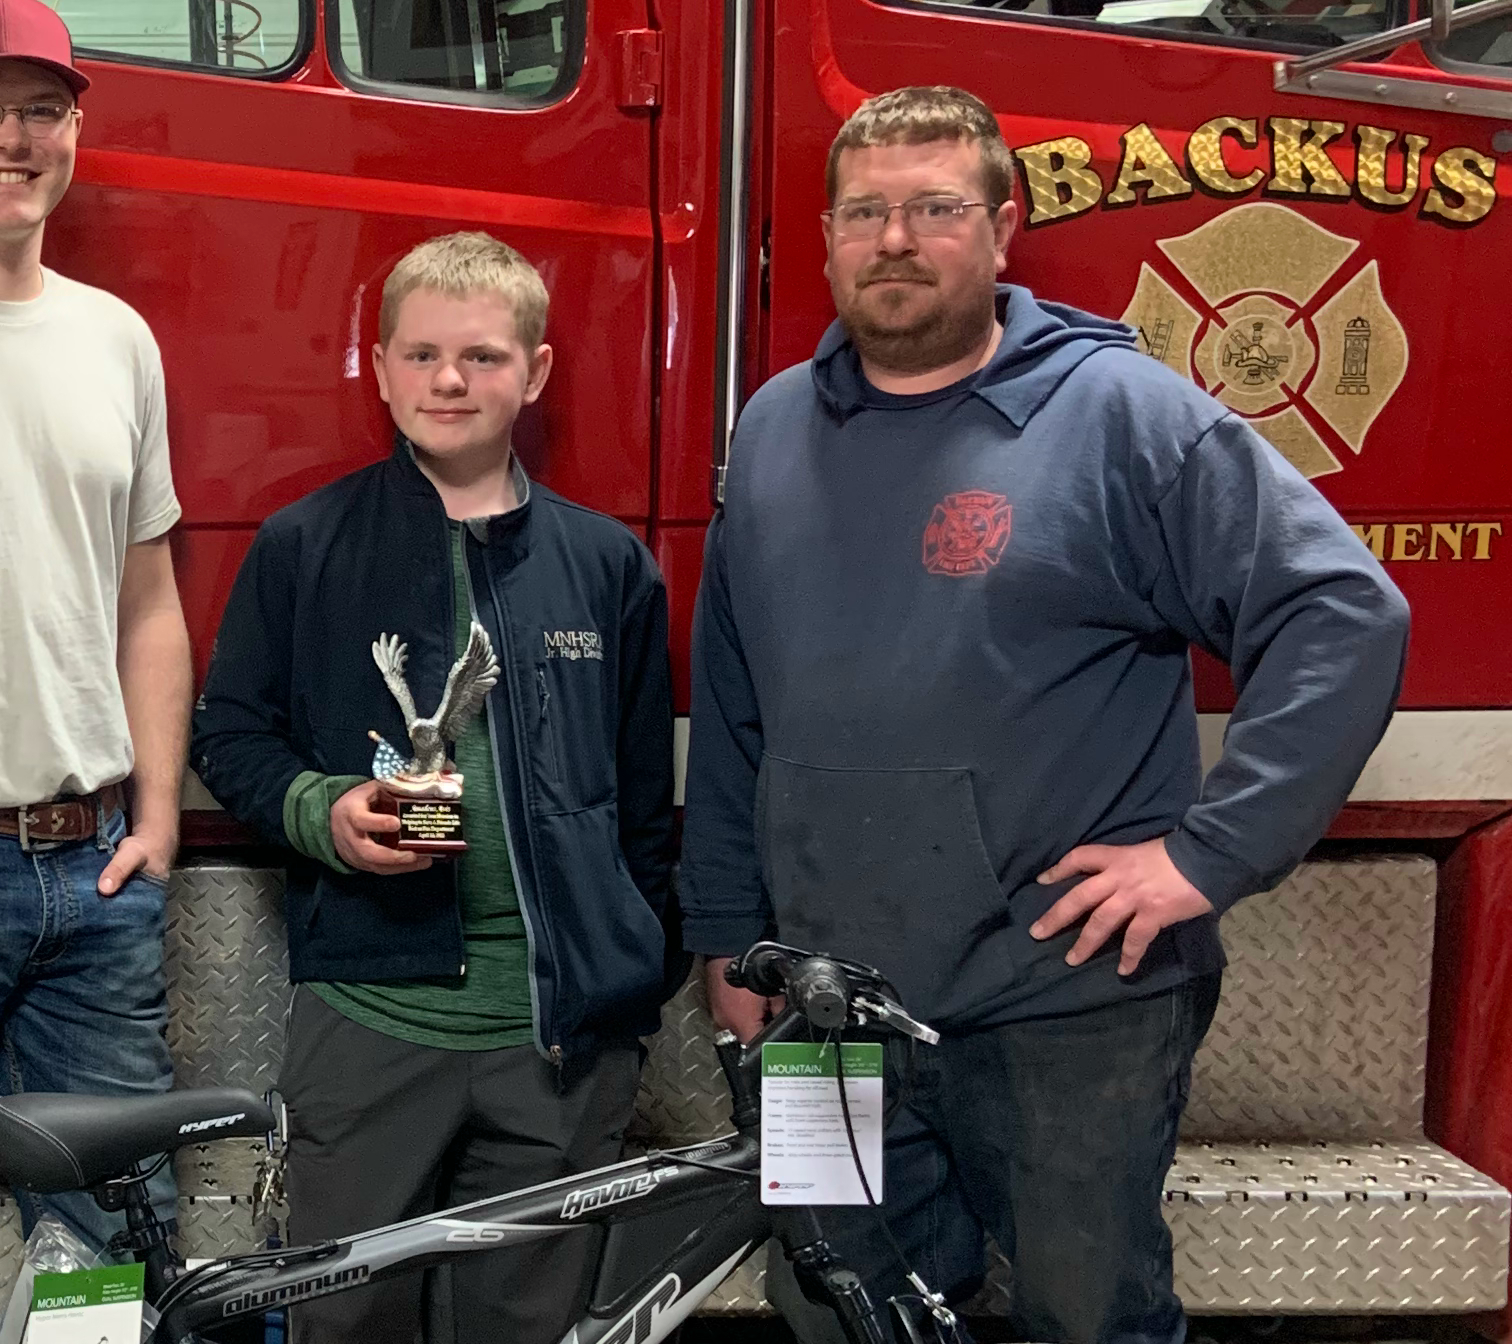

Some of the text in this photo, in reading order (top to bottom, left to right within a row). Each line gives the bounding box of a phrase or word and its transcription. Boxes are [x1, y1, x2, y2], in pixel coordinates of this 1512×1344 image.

[1014, 115, 1498, 229] BACKUS
[768, 1064, 822, 1074] MOUNTAIN
[652, 1165, 679, 1183] FS
[446, 1226, 504, 1243] 26
[223, 1264, 371, 1317] aluminum
[37, 1295, 86, 1309] MOUNTAIN
